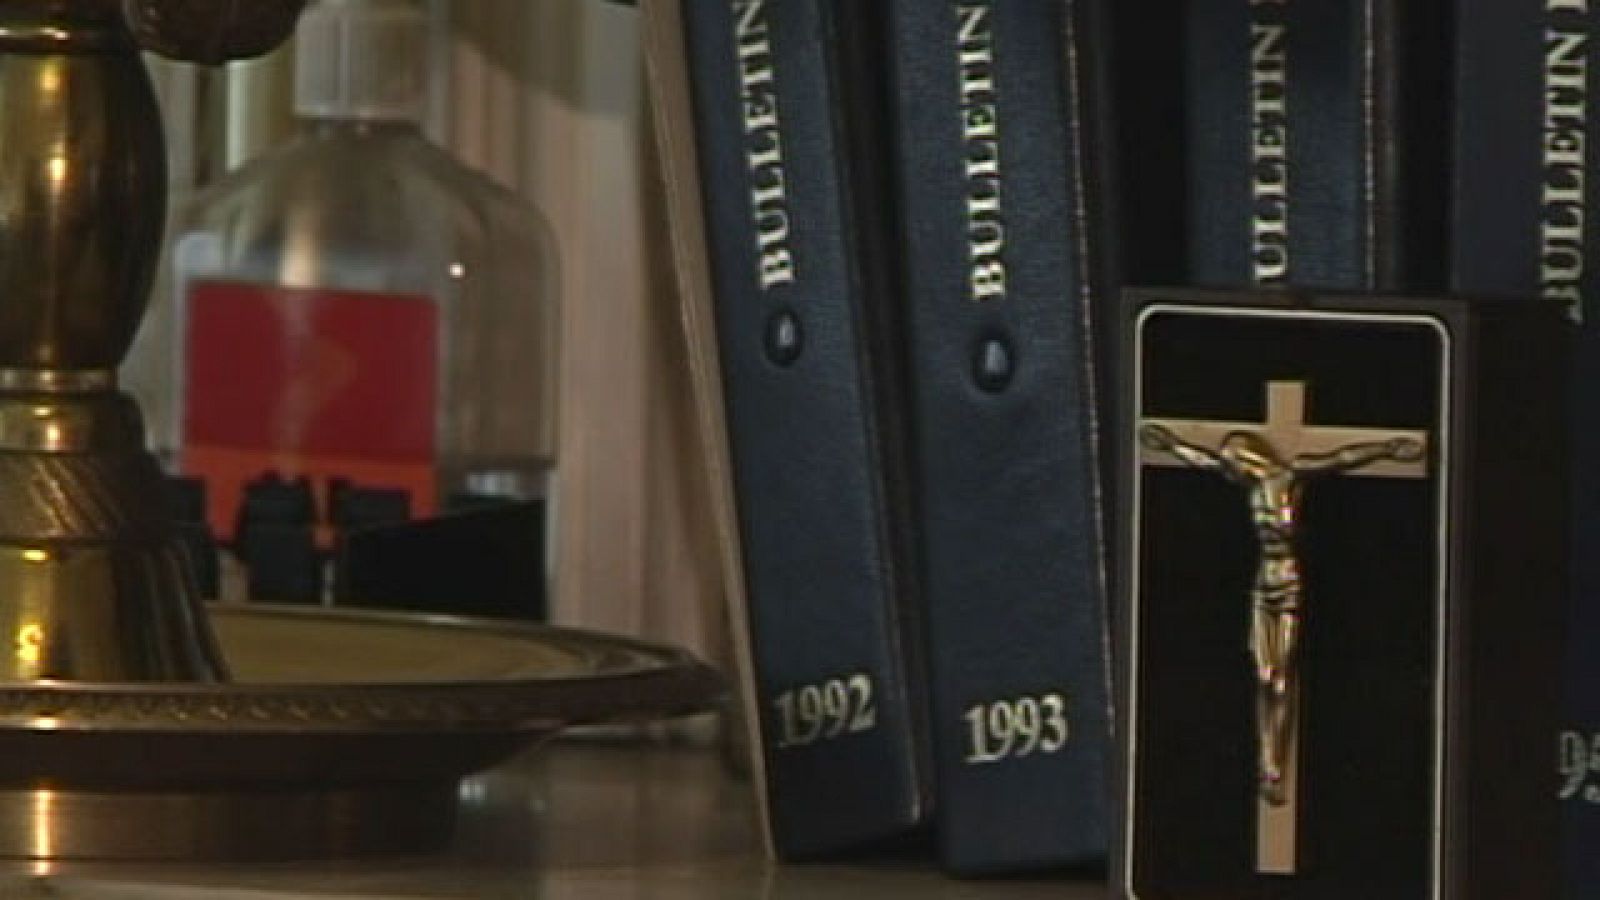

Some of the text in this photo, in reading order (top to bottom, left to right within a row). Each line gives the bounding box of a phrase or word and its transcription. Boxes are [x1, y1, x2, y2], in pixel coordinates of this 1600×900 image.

[733, 0, 796, 290] BULLETIN
[956, 4, 1005, 300] BULLETIN
[1252, 24, 1288, 289] ULLETIN
[774, 672, 876, 750] 1992
[963, 692, 1068, 764] 1993
